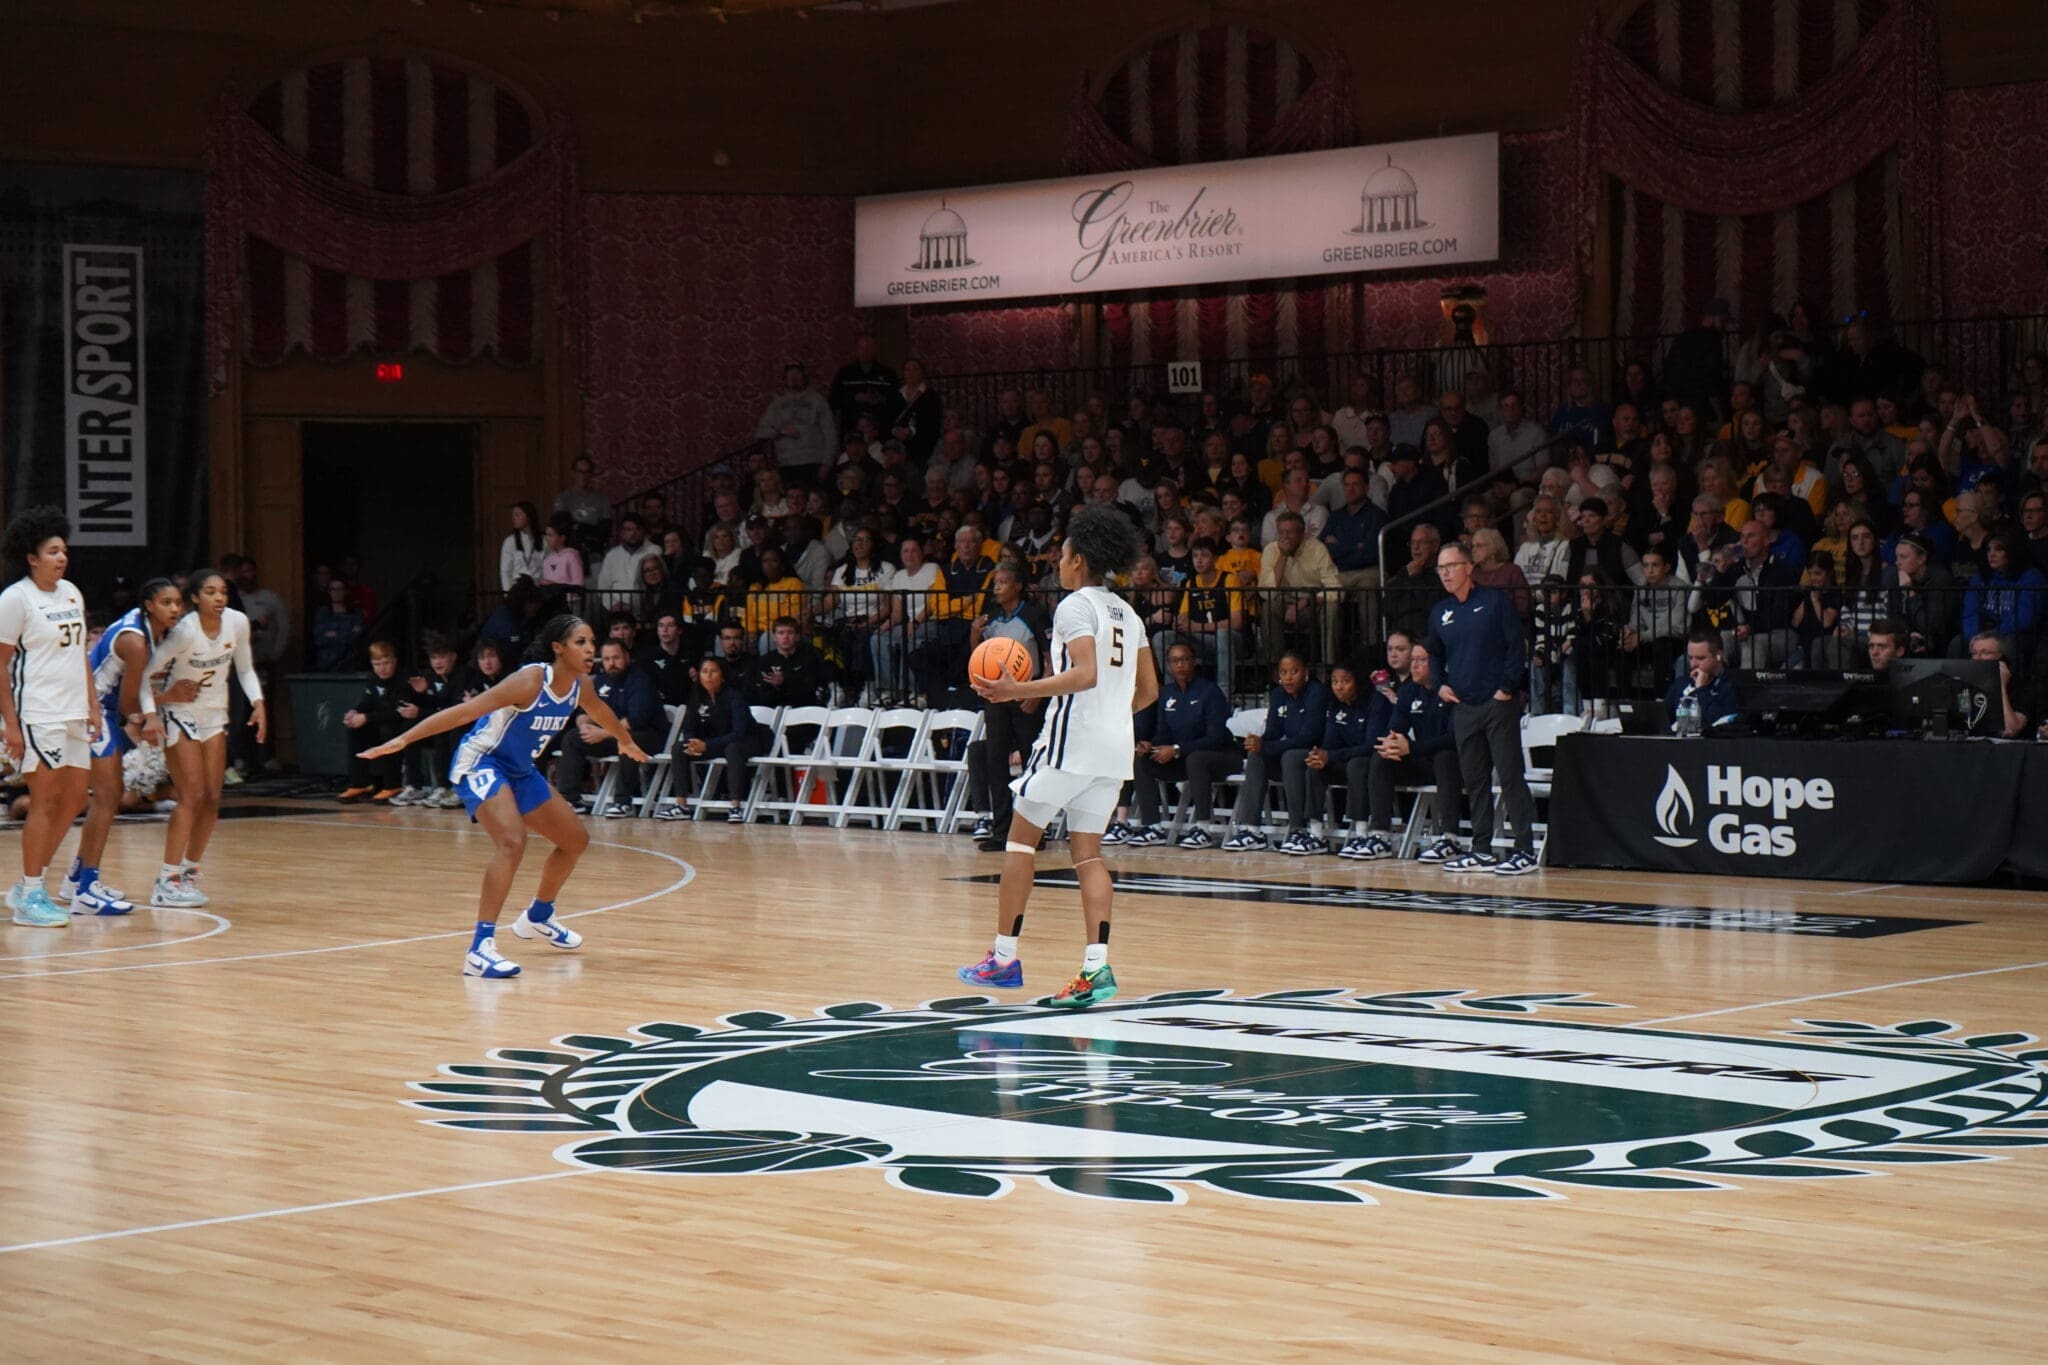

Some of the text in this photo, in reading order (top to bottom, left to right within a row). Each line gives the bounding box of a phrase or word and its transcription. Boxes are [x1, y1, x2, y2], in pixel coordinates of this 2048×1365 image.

[1148, 200, 1170, 214] The
[1071, 181, 1237, 283] Greenbrier
[1108, 242, 1243, 265] AMERICA'S RESORT
[1322, 238, 1457, 263] GREENBRIER.COM
[887, 275, 1000, 296] GREENBRIER.COM
[1171, 367, 1199, 387] 101
[58, 622, 82, 647] 37
[1110, 626, 1124, 668] 5
[199, 670, 216, 688] 2
[531, 734, 552, 759] 3
[1707, 765, 1835, 820] Hope
[1708, 813, 1797, 857] Gas
[1110, 1017, 1877, 1083] SKECHERS
[808, 1049, 1528, 1124] Greenbrier
[992, 1082, 1445, 1134] TIP-OFF
